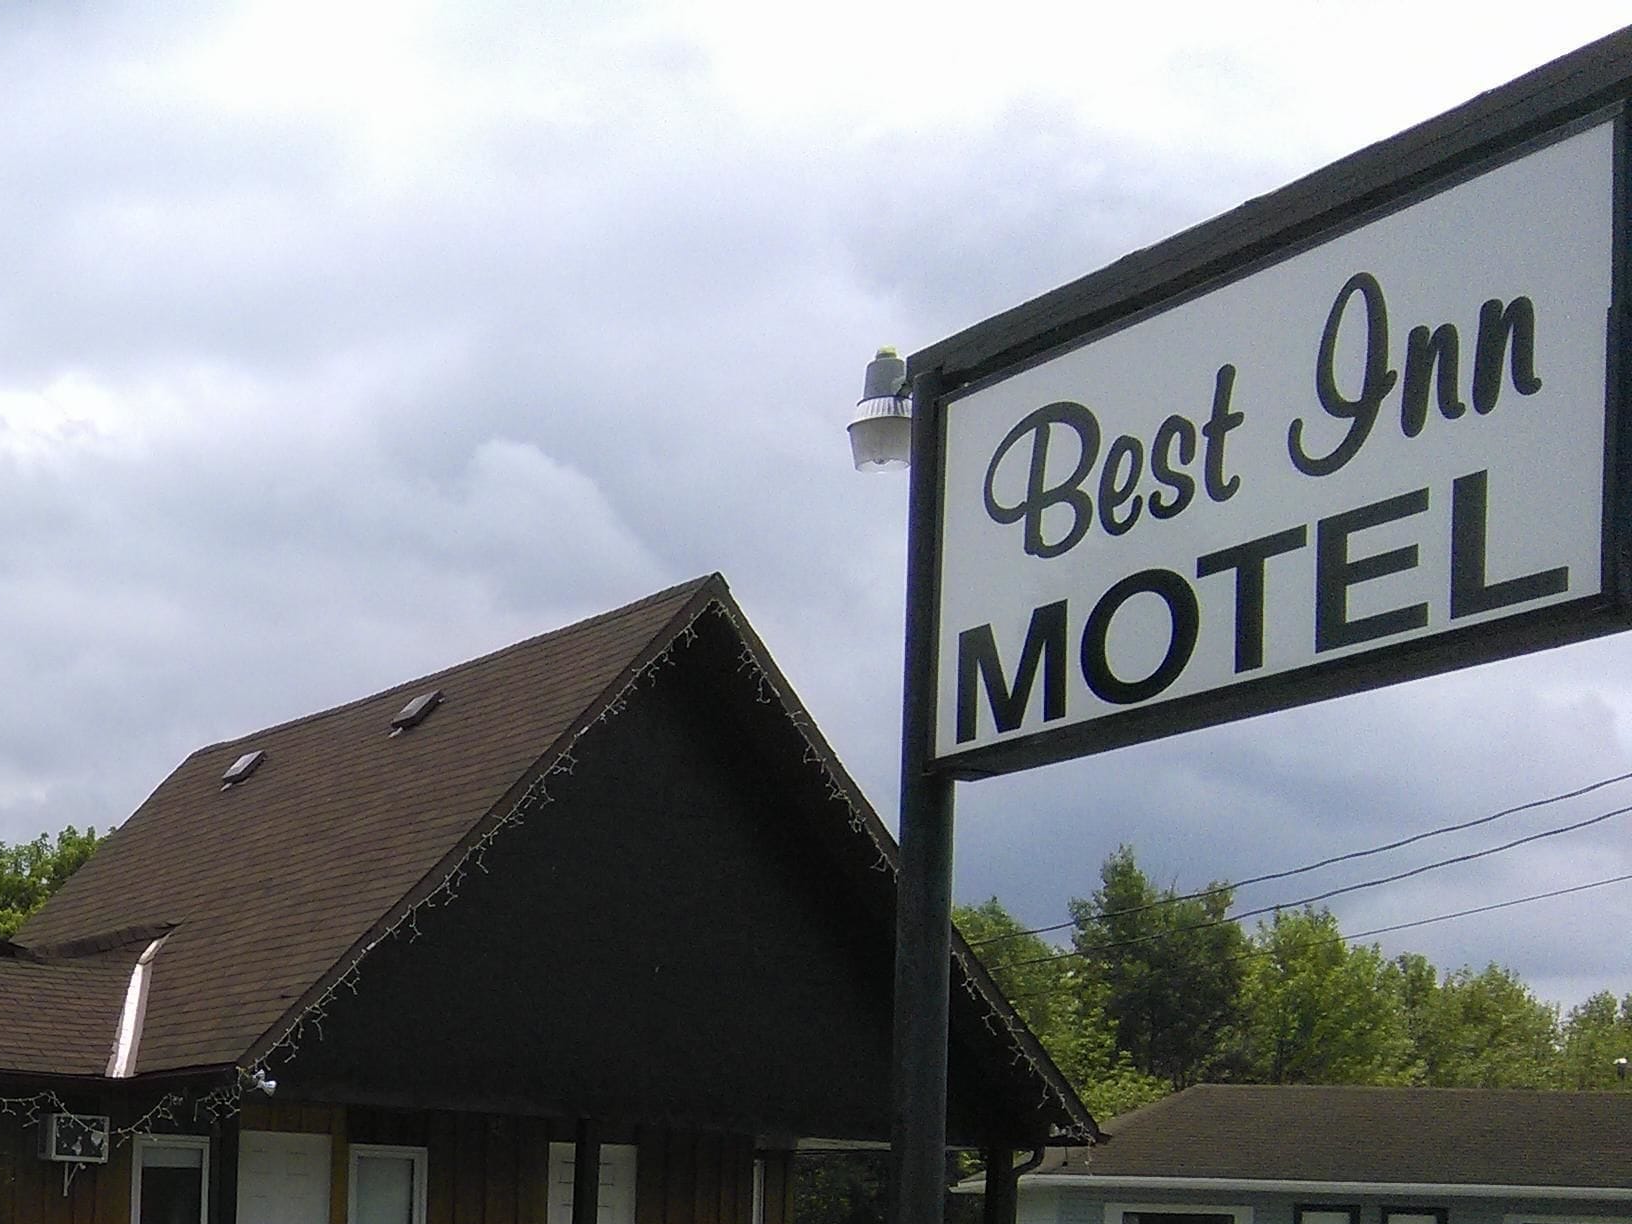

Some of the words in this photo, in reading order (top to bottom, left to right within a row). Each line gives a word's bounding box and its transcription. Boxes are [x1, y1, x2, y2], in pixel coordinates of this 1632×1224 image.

[983, 364, 1244, 558] Best
[1287, 272, 1542, 477] Inn
[956, 469, 1569, 745] MOTEL
